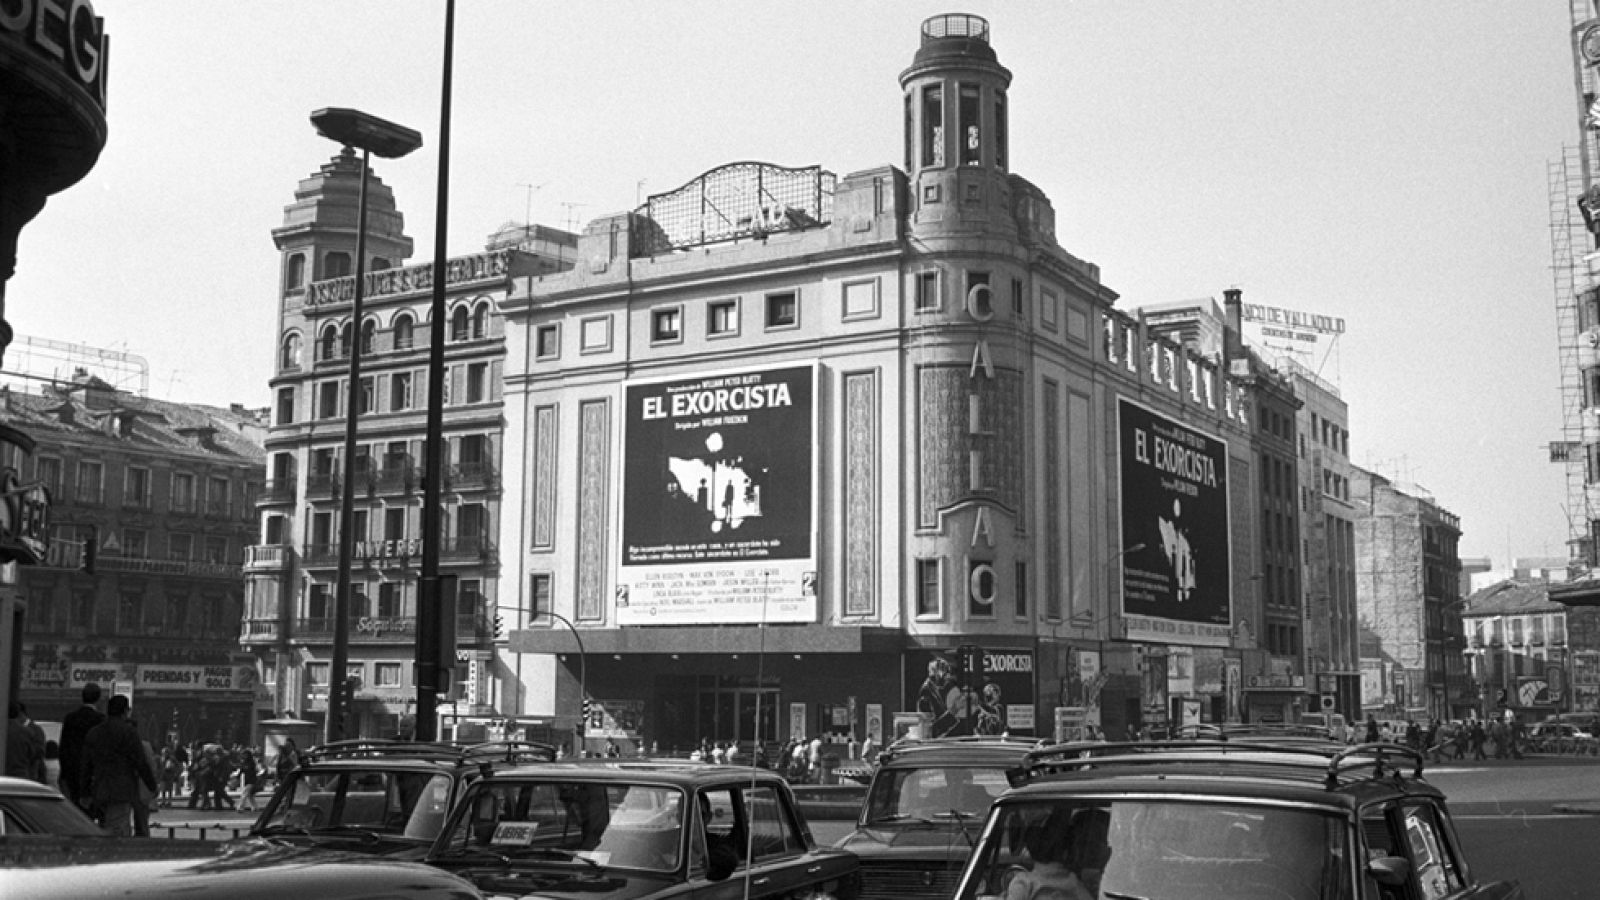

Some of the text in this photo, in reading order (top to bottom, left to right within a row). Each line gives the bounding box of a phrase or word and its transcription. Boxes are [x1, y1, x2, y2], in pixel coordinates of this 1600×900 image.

[642, 382, 792, 420] EL EXORCISTA
[967, 282, 997, 604] CALLAO
[1135, 427, 1151, 465] EL
[1154, 435, 1217, 488] EXORCISTA
[143, 670, 202, 684] PRENDAS Y
[206, 677, 231, 689] SOLO
